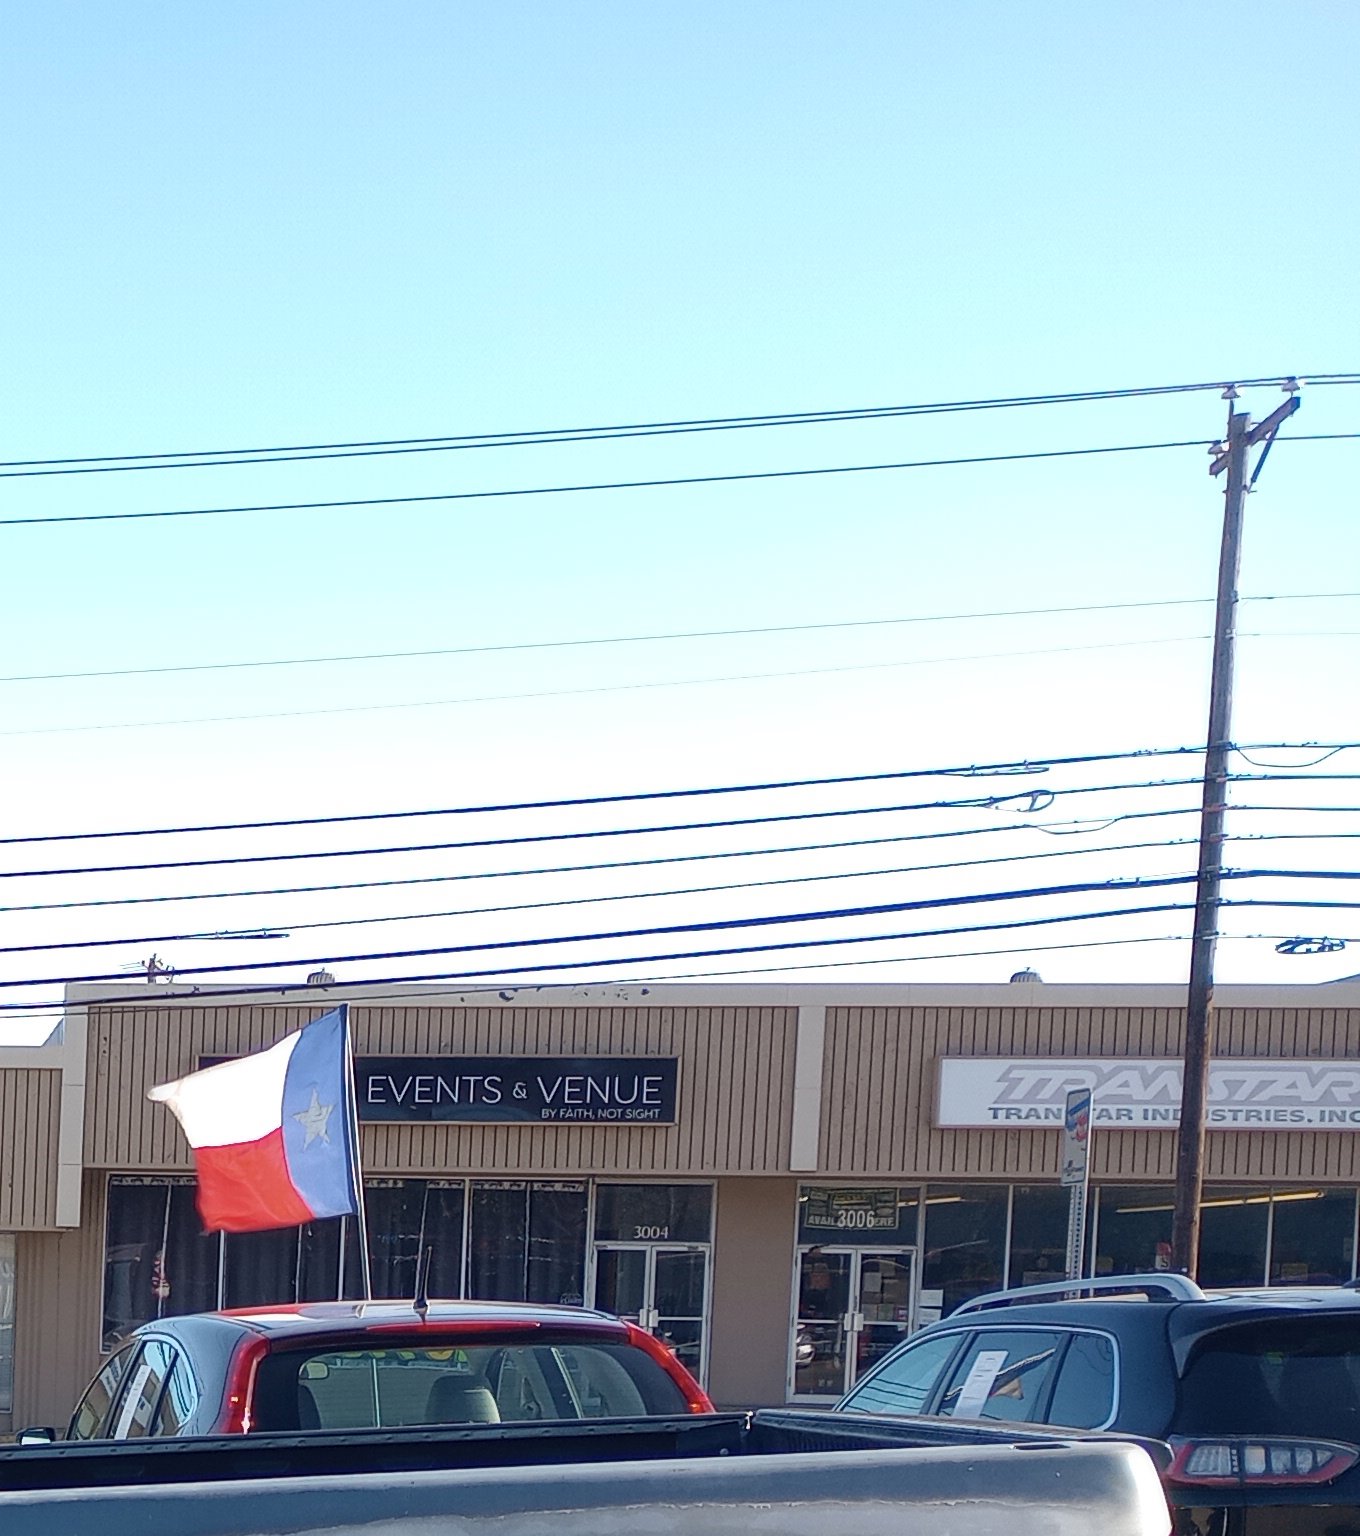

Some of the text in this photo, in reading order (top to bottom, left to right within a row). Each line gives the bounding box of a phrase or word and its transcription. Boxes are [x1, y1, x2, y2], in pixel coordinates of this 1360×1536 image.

[367, 1075, 663, 1104] EVENTS & VENUE
[542, 1106, 660, 1120] BY FAITH, NOT SIGHT
[988, 1107, 1133, 1121] TRANAR
[1143, 1108, 1313, 1123] INDSTRIES.
[837, 1210, 875, 1228] 3006
[633, 1225, 668, 1239] 3004
